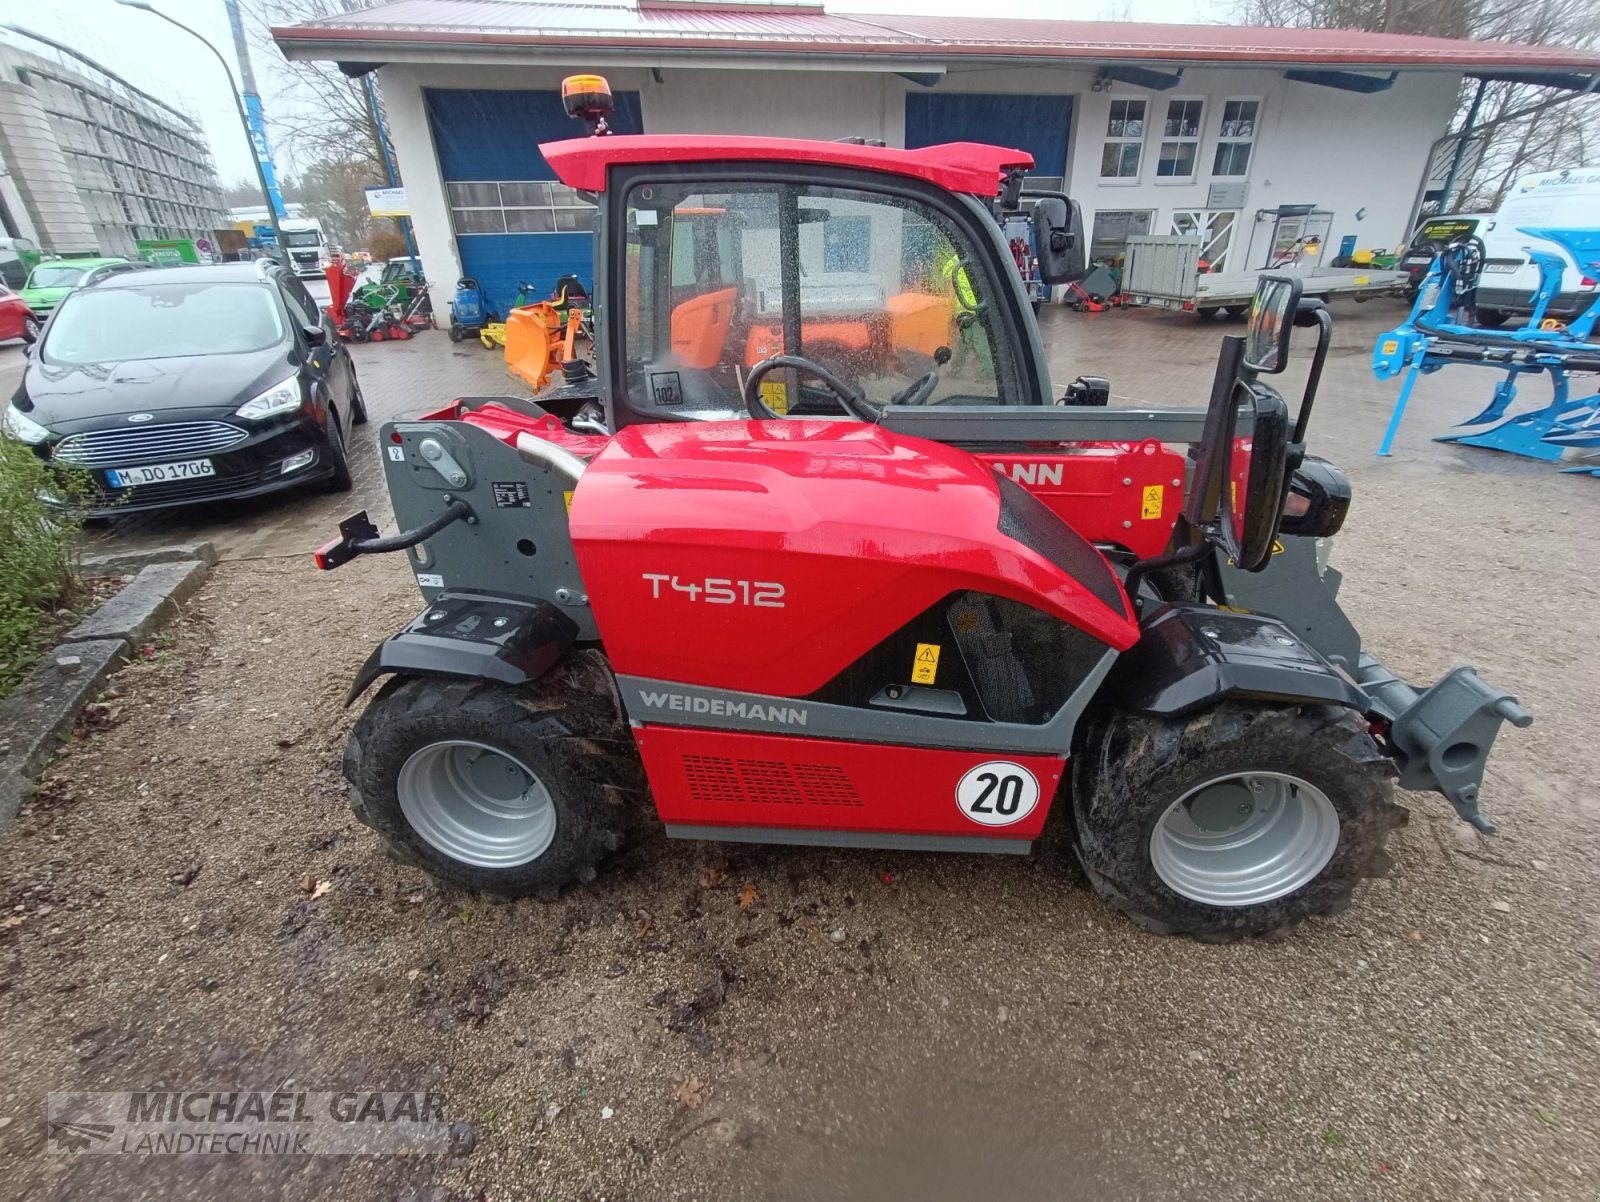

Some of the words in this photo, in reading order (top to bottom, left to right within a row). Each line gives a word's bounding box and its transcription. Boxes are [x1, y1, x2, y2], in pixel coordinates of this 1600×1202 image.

[655, 386, 674, 403] 102
[118, 471, 133, 485] M
[141, 467, 165, 481] DO
[168, 461, 211, 478] 1706
[641, 573, 786, 608] T4512
[638, 690, 808, 726] WEIDEMANN
[970, 772, 1024, 816] 20
